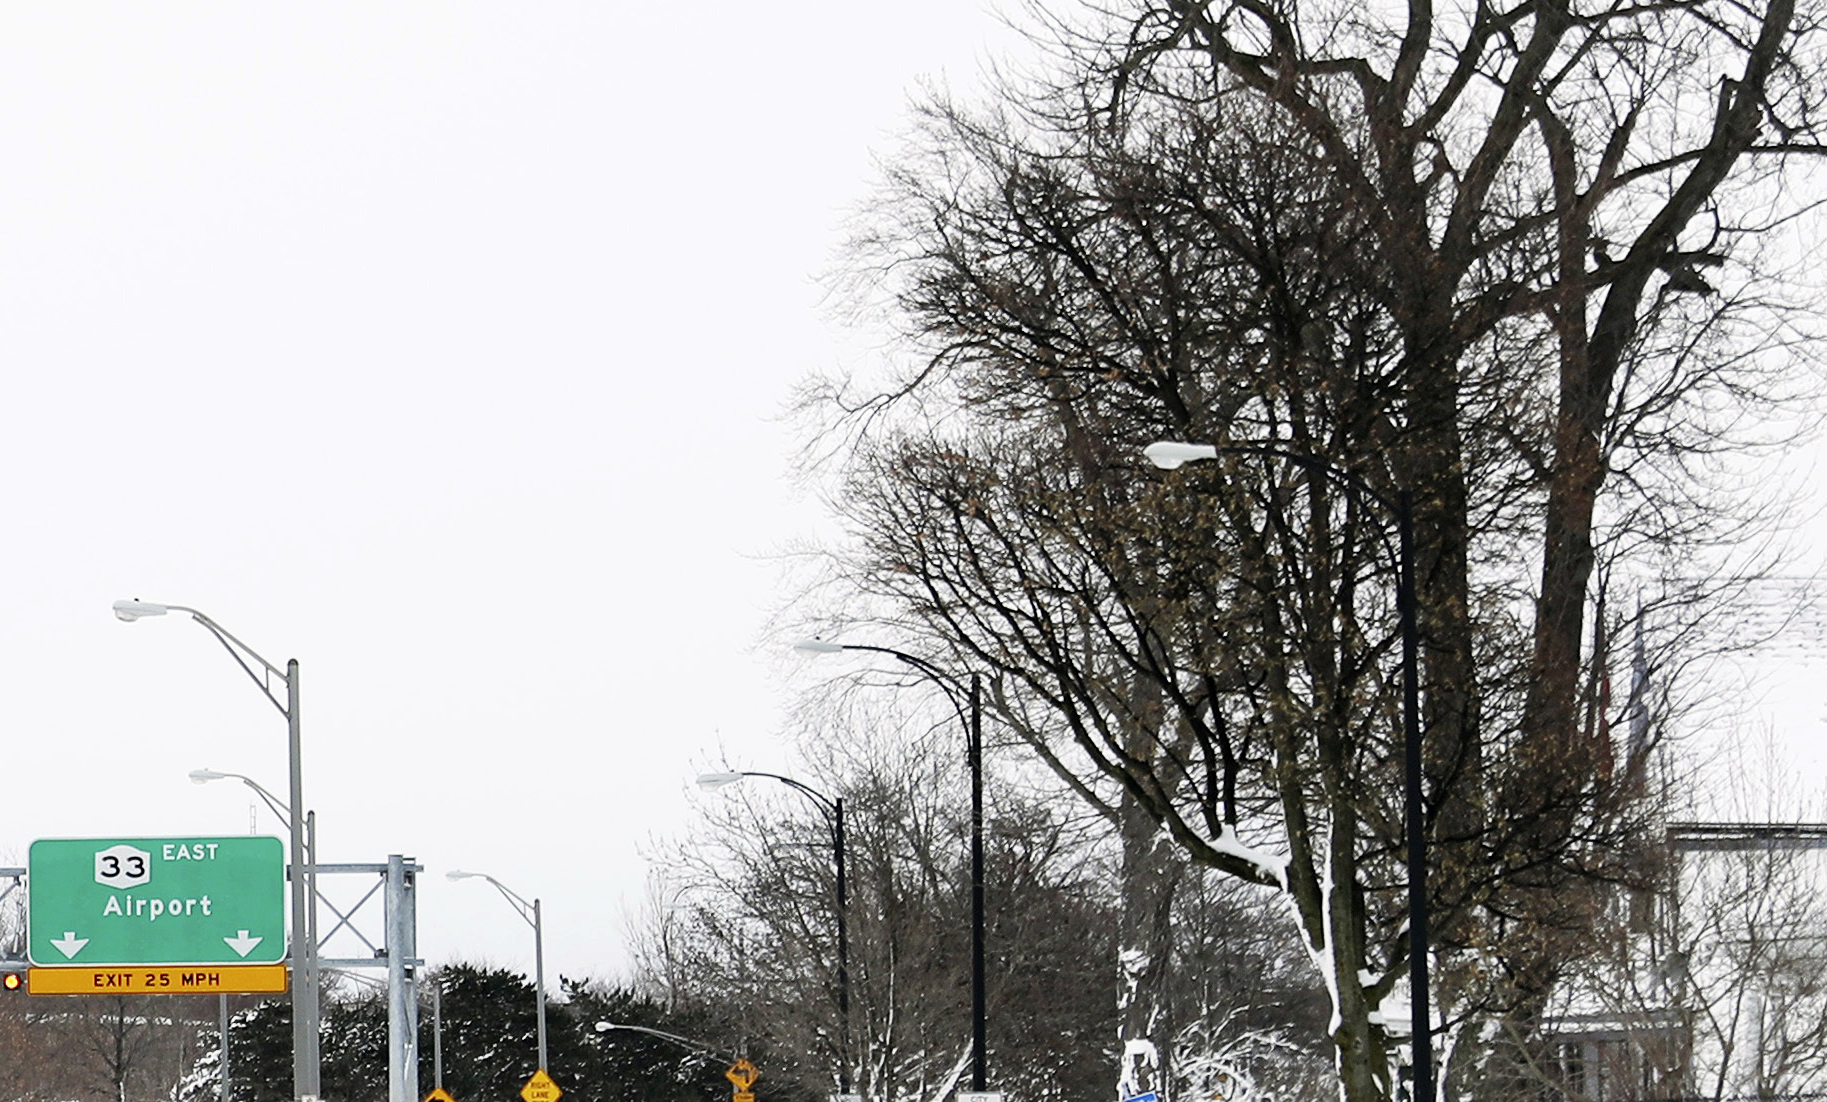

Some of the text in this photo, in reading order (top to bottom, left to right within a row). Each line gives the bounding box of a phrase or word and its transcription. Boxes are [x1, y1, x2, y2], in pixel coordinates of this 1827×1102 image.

[163, 844, 219, 860] EAST
[101, 856, 145, 878] 33
[103, 895, 212, 921] Airport
[94, 973, 219, 987] EXIT 25 MPH
[531, 1091, 549, 1099] LANE
[970, 1095, 989, 1102] CITY
